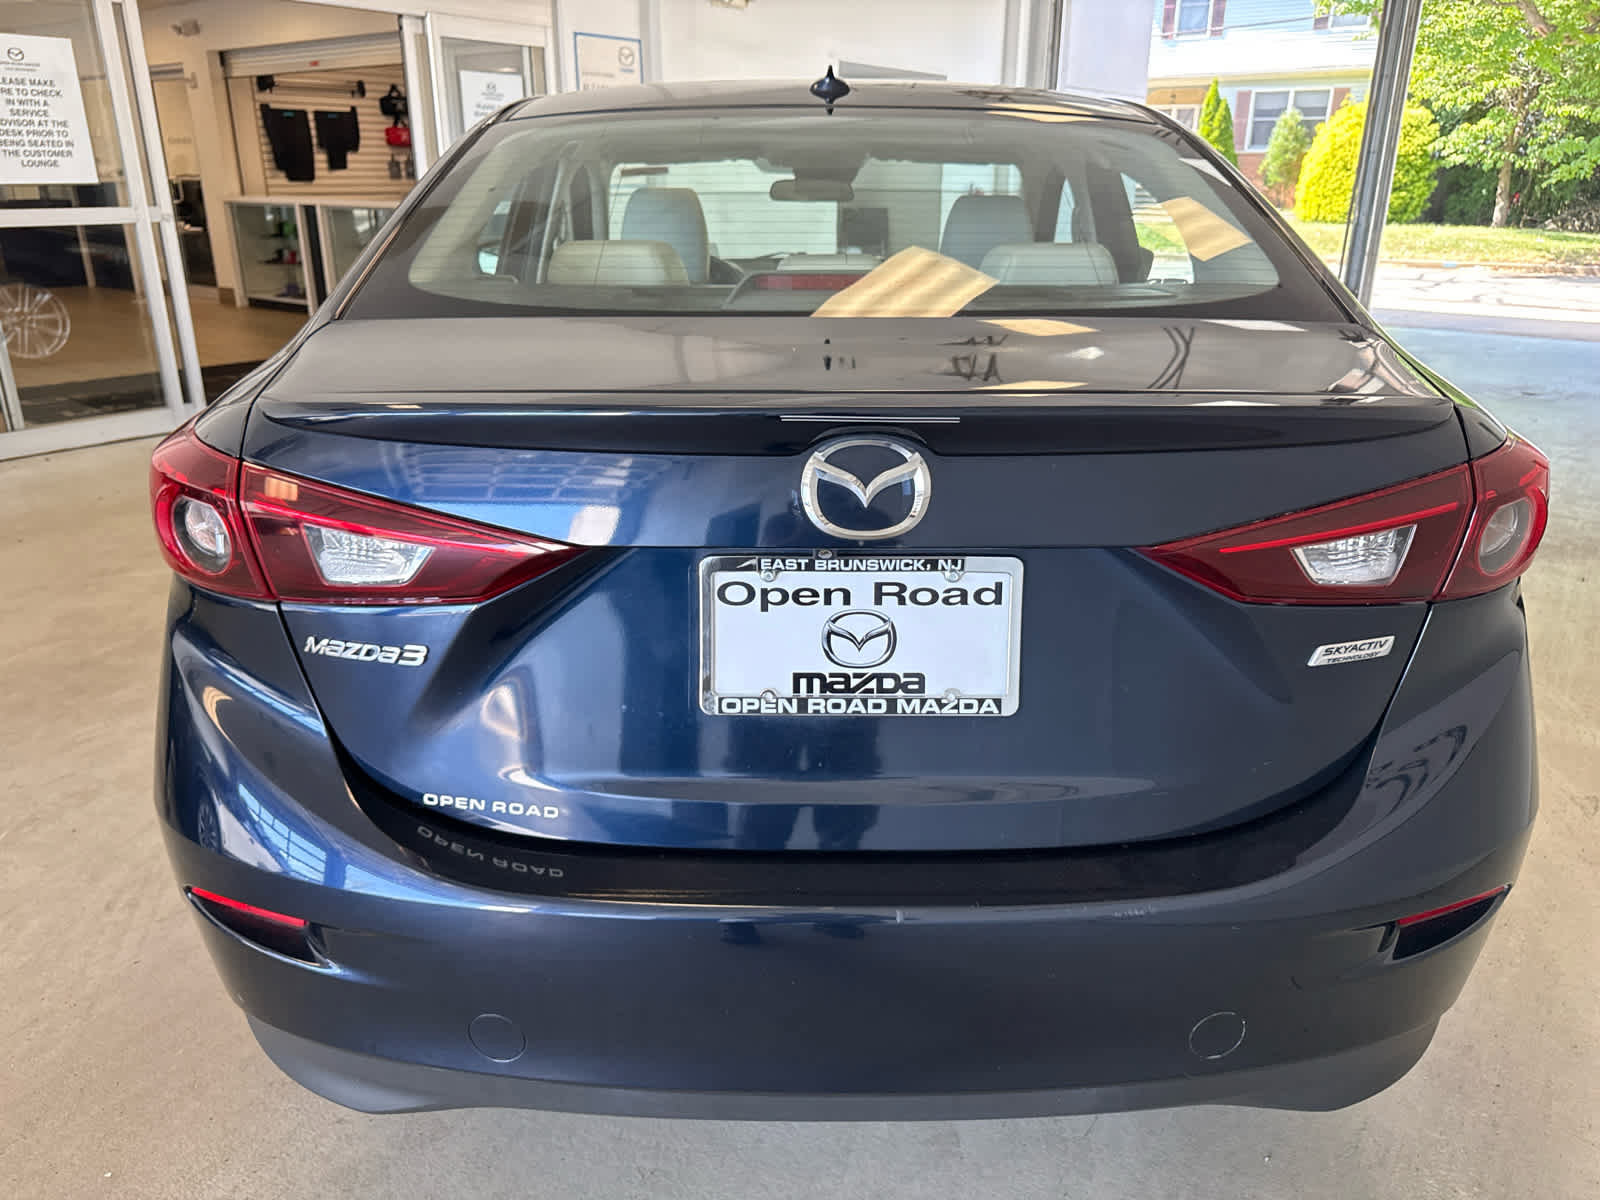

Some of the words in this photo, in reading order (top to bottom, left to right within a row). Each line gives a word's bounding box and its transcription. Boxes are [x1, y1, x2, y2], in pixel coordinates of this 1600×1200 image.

[0, 77, 27, 86] EASE
[29, 78, 56, 87] MAKE
[15, 88, 29, 97] TO
[31, 89, 63, 98] CHECK
[6, 98, 15, 106] IN
[16, 98, 41, 107] WITH
[43, 99, 49, 107] A
[9, 108, 49, 118] SERVICE
[38, 119, 48, 128] AT
[51, 119, 69, 129] THE
[26, 129, 54, 138] PRIOR
[56, 129, 69, 138] TO
[27, 139, 64, 148] SEATED
[65, 140, 74, 149] IN
[2, 148, 21, 158] THE
[23, 149, 73, 159] CUSTOMER
[760, 558, 809, 571] EAST
[814, 558, 932, 572] BRUNSWICK,
[937, 558, 963, 572] NJ
[716, 581, 851, 613] Open
[873, 581, 1003, 606] Road
[303, 635, 428, 667] Mazda3
[1322, 640, 1388, 656] SKYACTIV
[1327, 650, 1383, 663] TECHNOLOGY
[792, 672, 926, 694] mazda
[721, 698, 798, 714] OPEN
[807, 698, 888, 714] ROAD
[896, 698, 1000, 714] MAZDA
[422, 793, 486, 811] OPEN
[491, 801, 560, 819] ROAD
